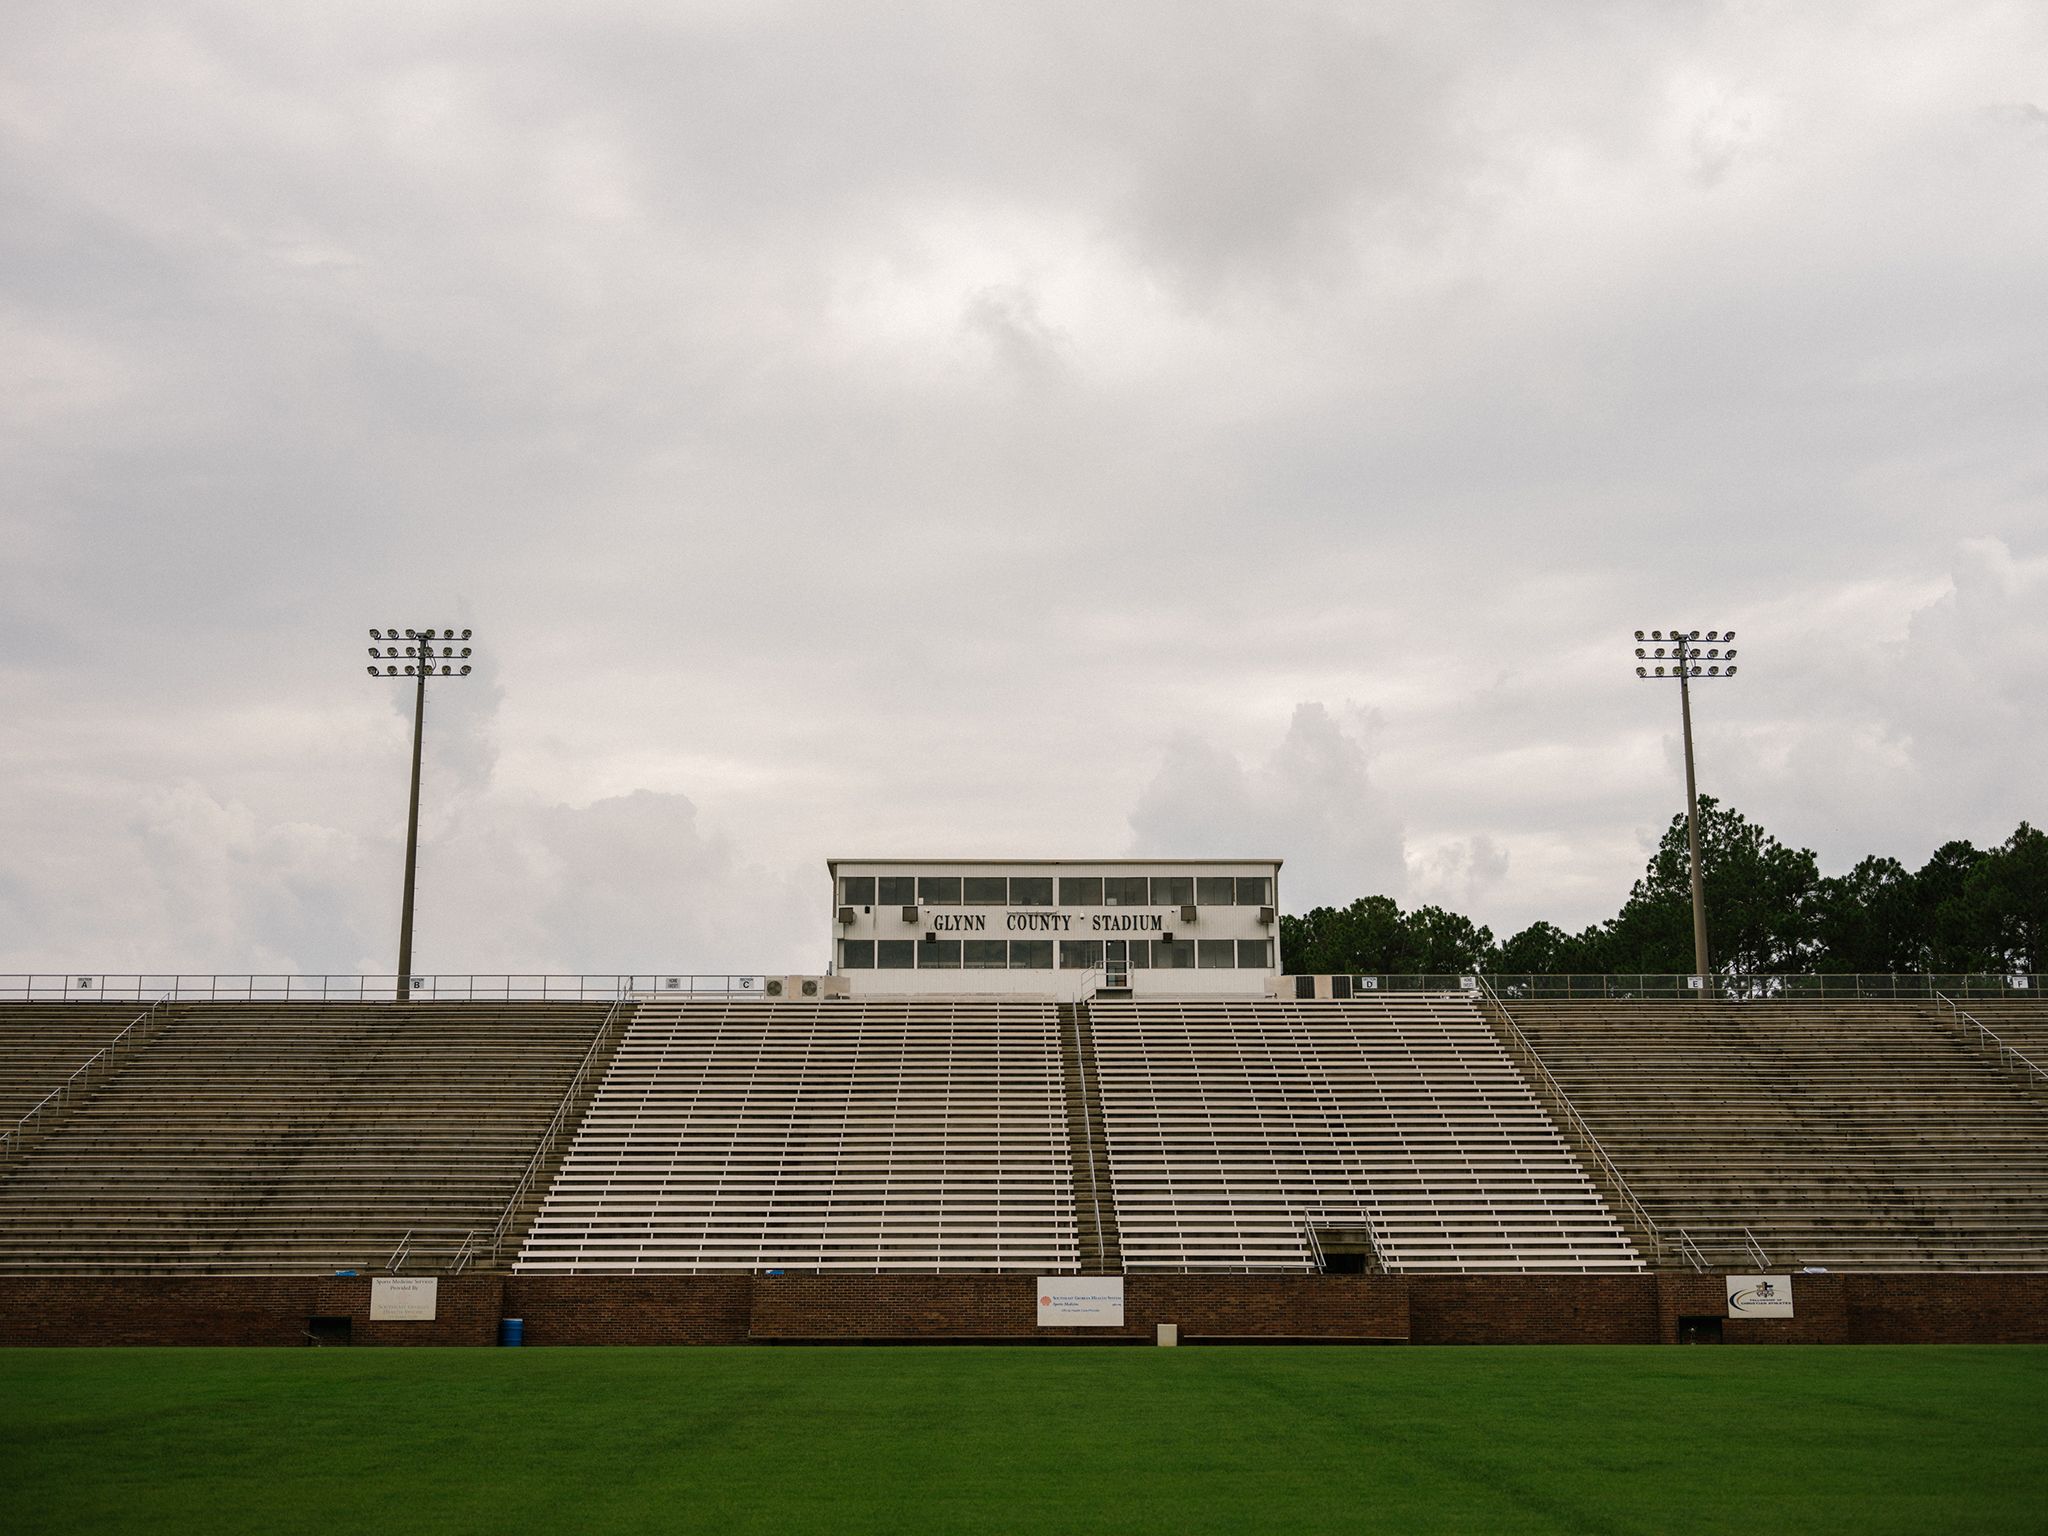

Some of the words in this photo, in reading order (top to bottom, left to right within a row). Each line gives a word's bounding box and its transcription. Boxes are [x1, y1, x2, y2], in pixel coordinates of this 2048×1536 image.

[934, 915, 986, 931] GLYNN
[1006, 915, 1072, 931] COUNTY
[1092, 915, 1163, 931] STADIUM
[414, 981, 420, 989] B
[743, 981, 750, 989] C
